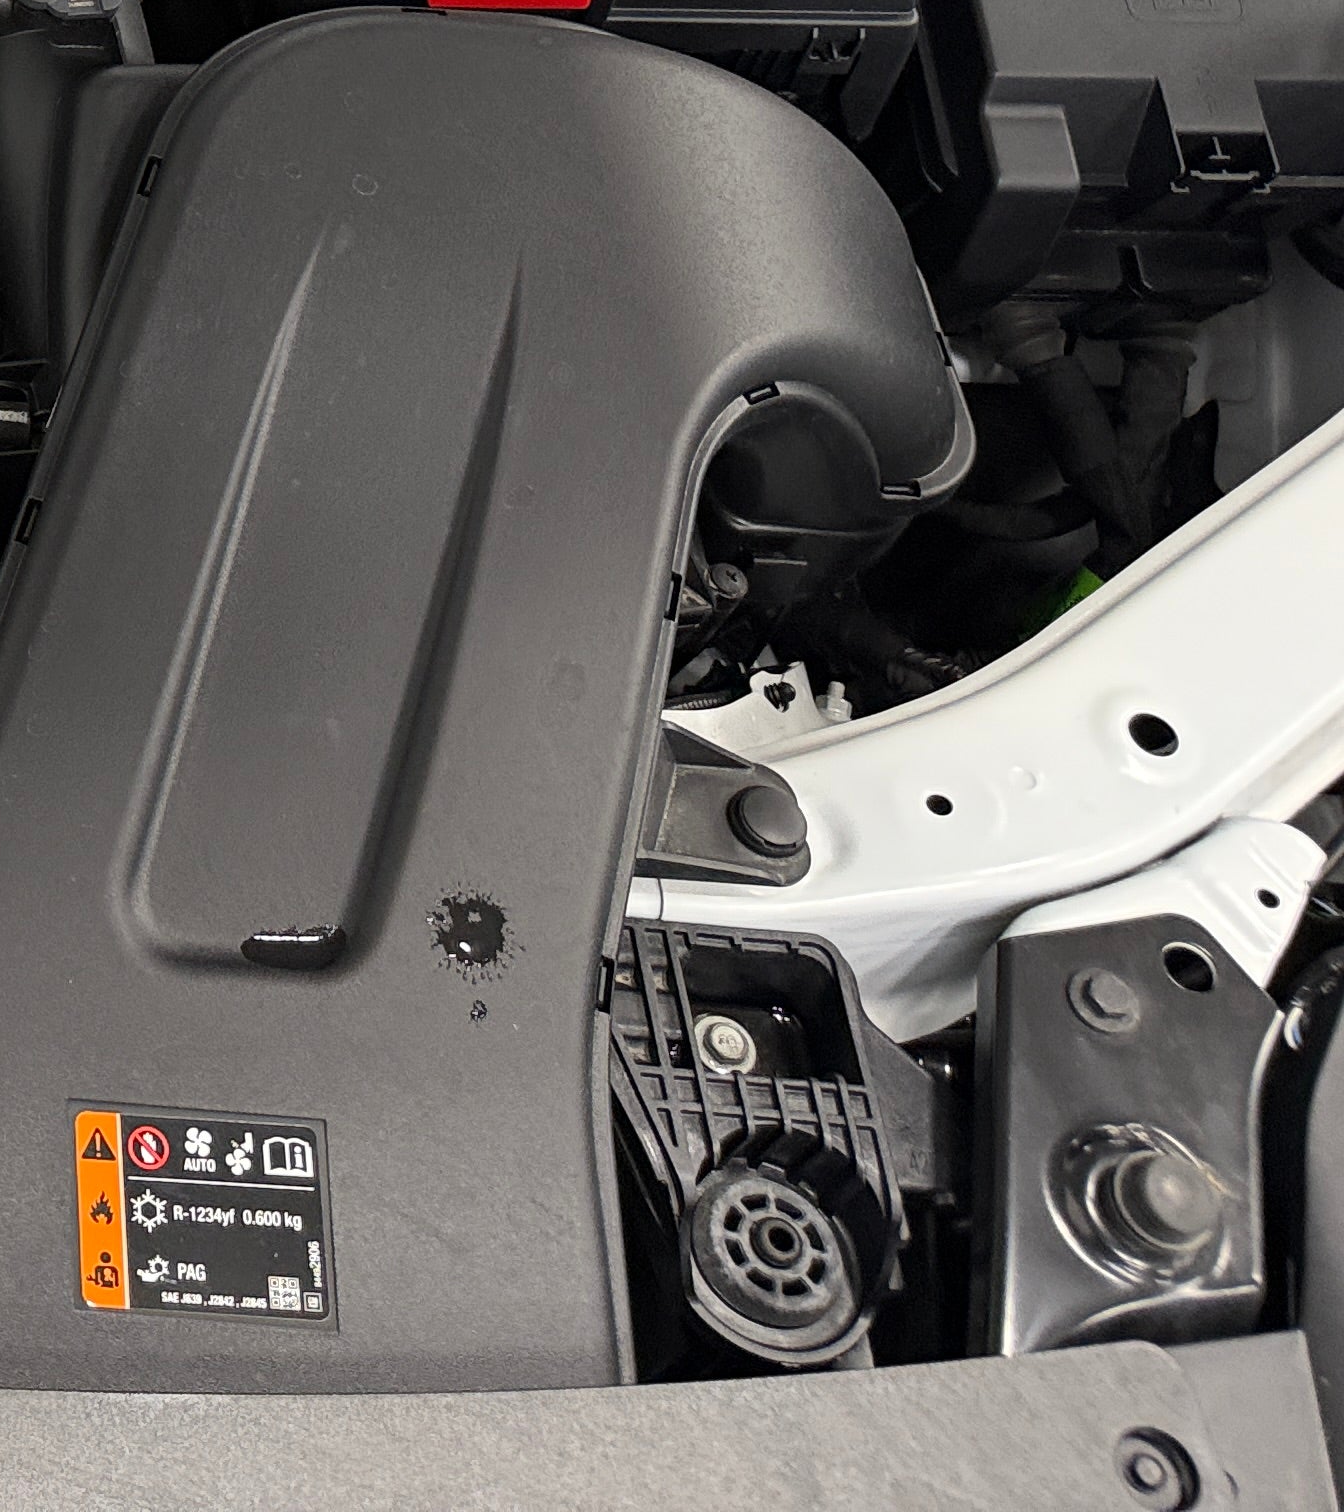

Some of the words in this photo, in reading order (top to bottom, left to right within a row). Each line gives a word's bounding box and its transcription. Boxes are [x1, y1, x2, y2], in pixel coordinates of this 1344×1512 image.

[183, 1158, 217, 1173] AUTO
[173, 1204, 236, 1227] R-1234yf
[242, 1209, 282, 1227] 0.600
[284, 1212, 303, 1231] kg
[177, 1262, 207, 1281] PAG
[161, 1291, 179, 1303] SAE
